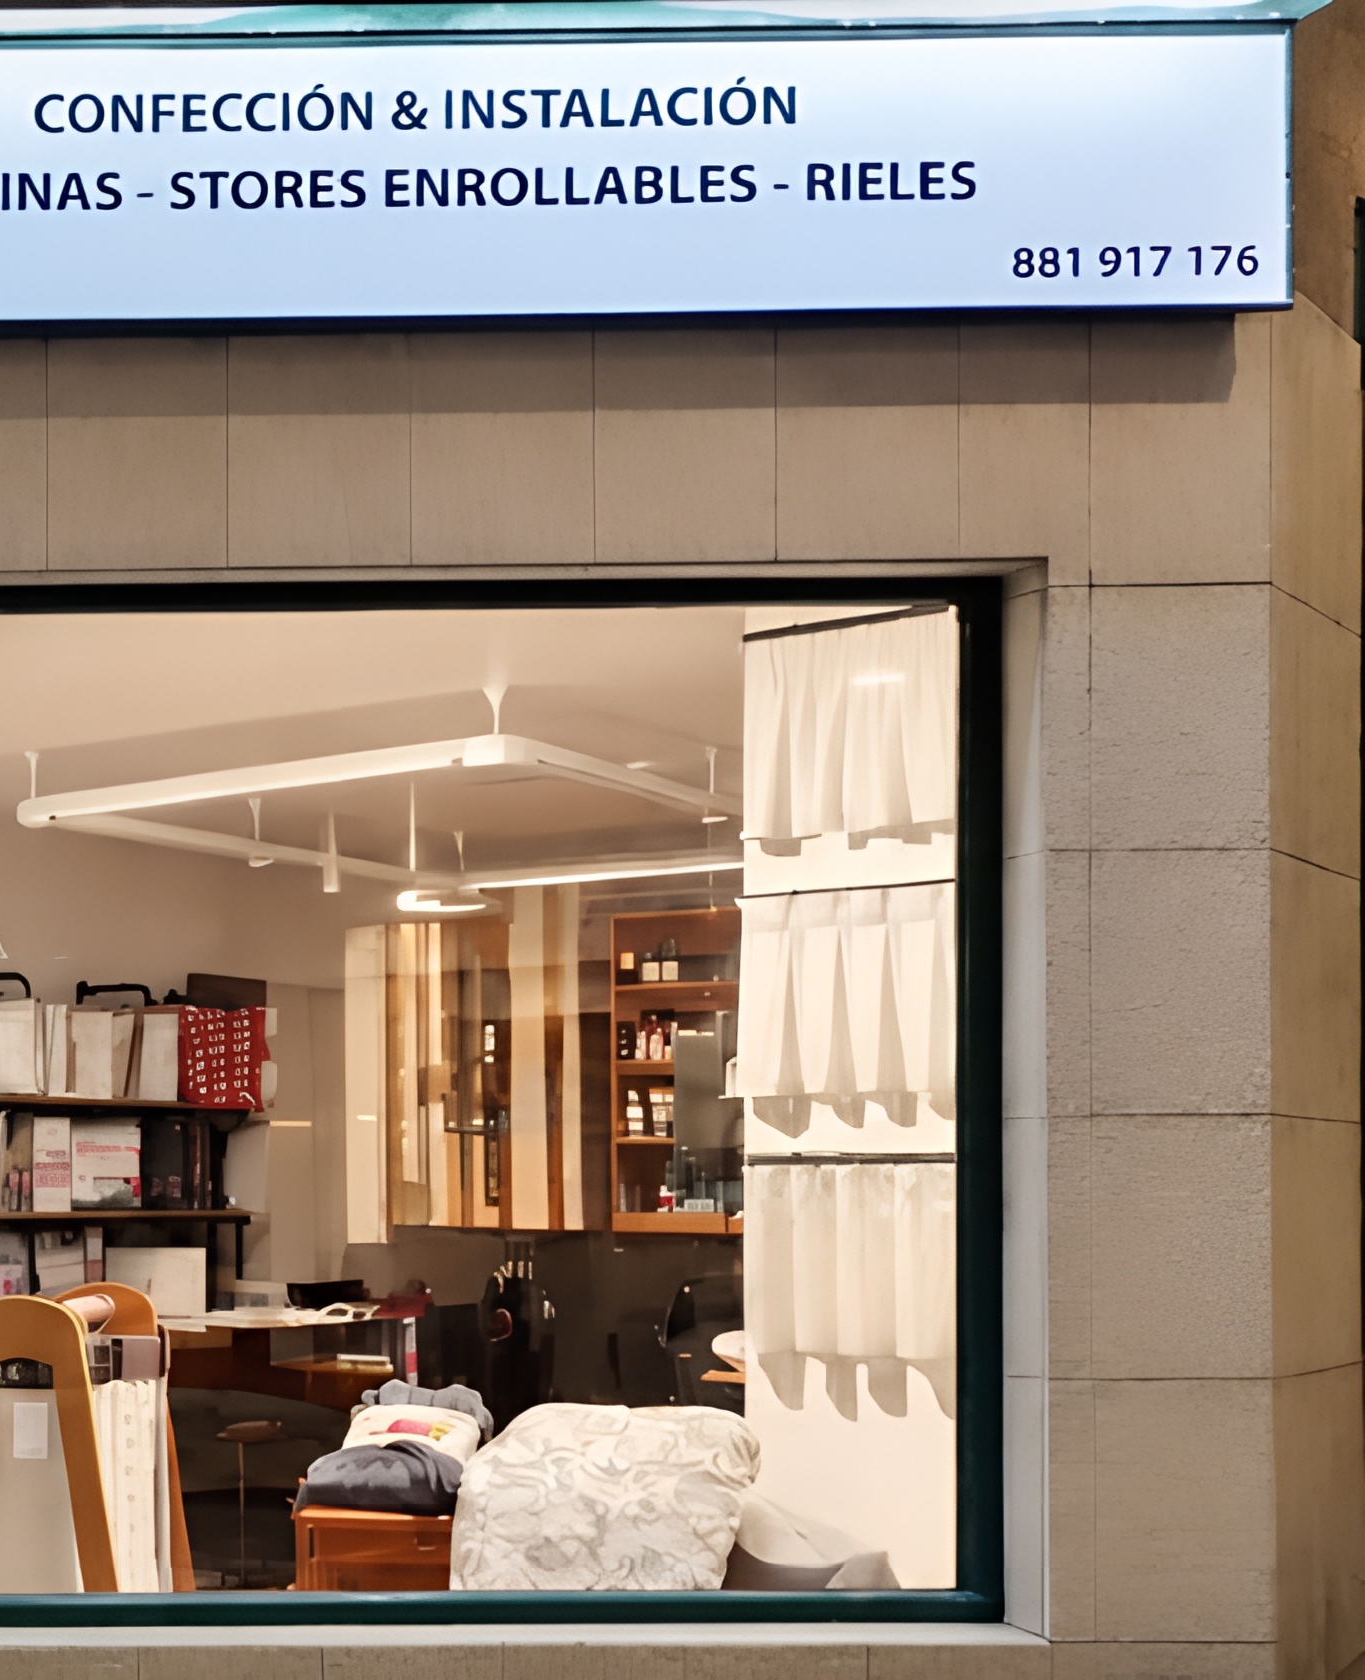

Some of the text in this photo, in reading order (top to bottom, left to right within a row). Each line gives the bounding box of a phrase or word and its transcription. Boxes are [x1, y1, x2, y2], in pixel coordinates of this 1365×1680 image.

[34, 76, 796, 134] CONFECCIÓN & INSTALACIÓN
[170, 169, 367, 210] STORES
[384, 164, 757, 208] ENROLLABLES
[806, 160, 977, 201] RIELES
[1012, 244, 1259, 279] 881 917 176
